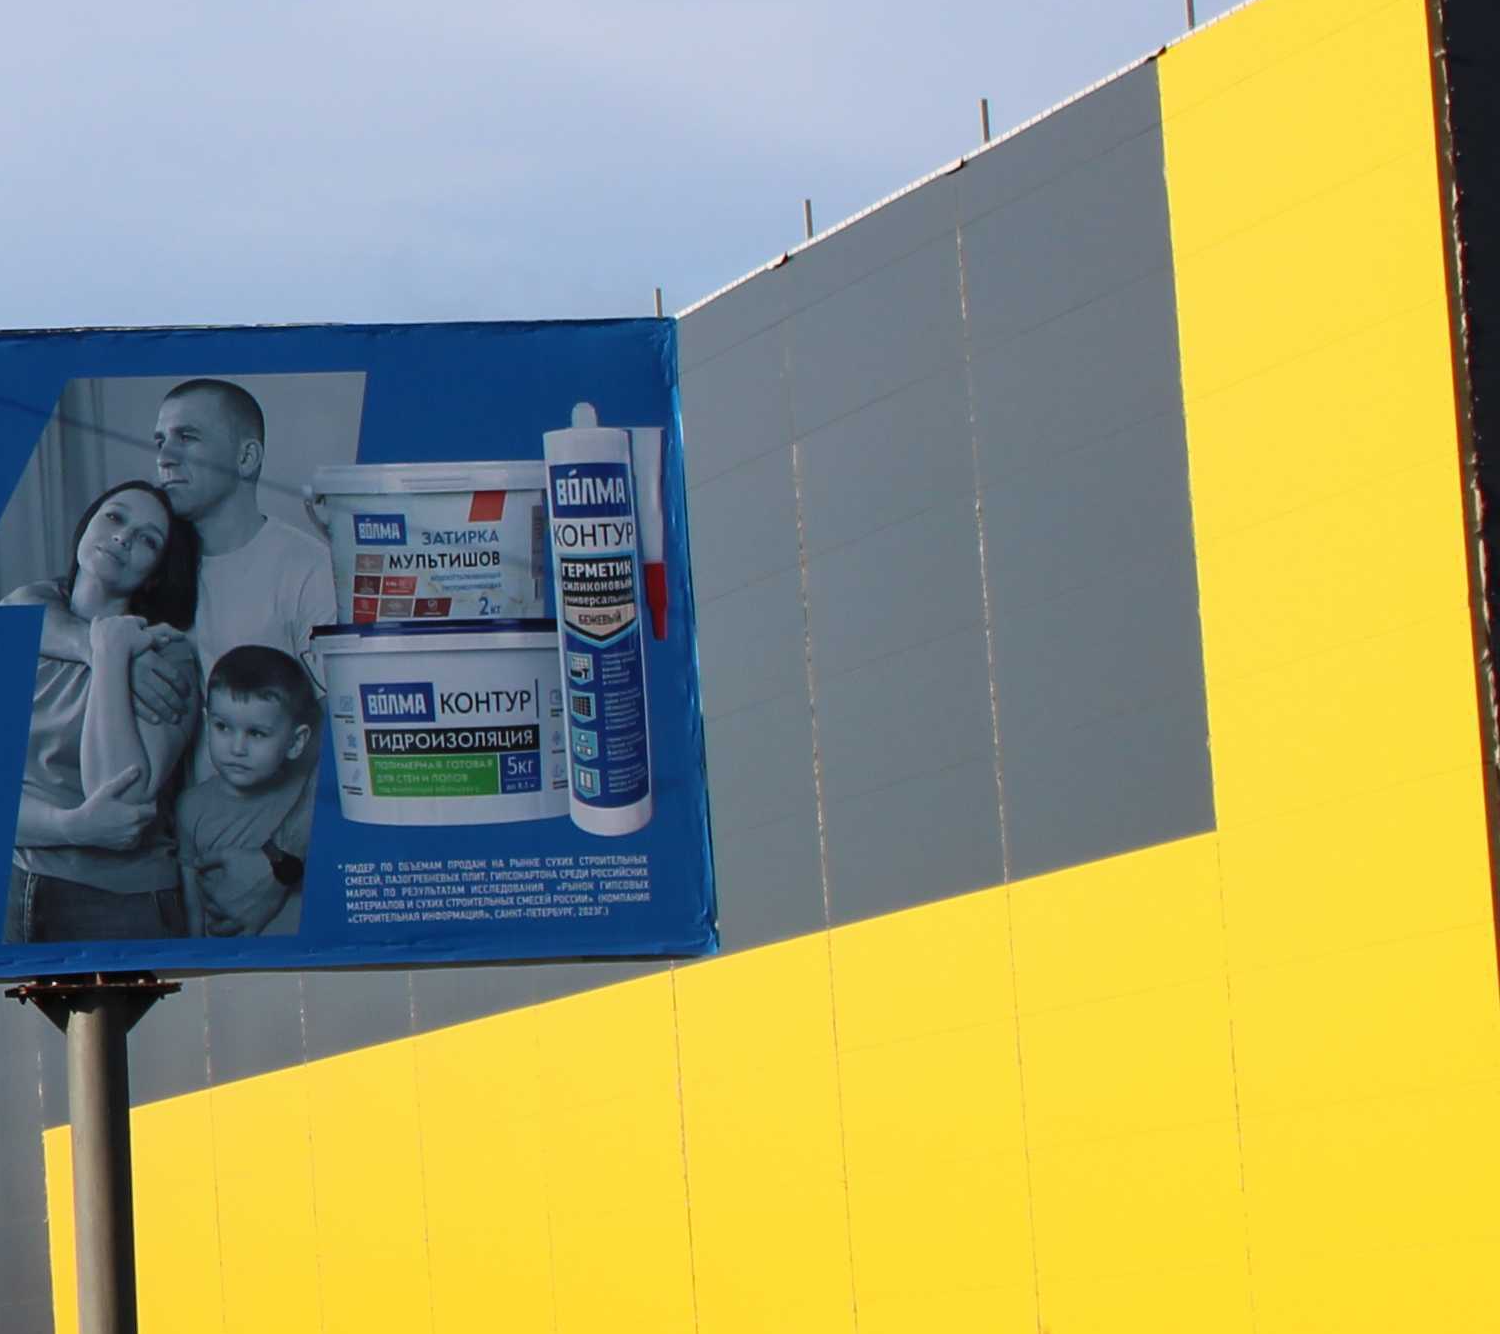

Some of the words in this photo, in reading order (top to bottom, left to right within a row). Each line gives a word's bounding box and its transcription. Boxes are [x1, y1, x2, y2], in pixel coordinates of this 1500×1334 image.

[421, 530, 500, 546] ЗАТИРКА
[554, 522, 634, 548] КОНТУР
[388, 551, 501, 570] МУЛЬТИШОВ
[561, 559, 632, 579] ГЕРМЕТИК
[478, 596, 489, 616] 2
[439, 689, 532, 714] КОНТУР
[371, 728, 534, 752] ГИДРОИЗОЛЯЦИЯ
[491, 858, 505, 868] НА
[509, 857, 541, 868] РЫНКЕ
[545, 856, 574, 867] СУХИХ
[579, 854, 648, 866] СТРОИТЕЛЬНЫХ
[559, 868, 590, 880] СРЕДИ
[345, 888, 379, 899] МАРОК
[383, 887, 396, 898] ПО
[401, 885, 465, 898] РЕЗУЛЬТАТАМ
[599, 880, 650, 890] ГИПСОВЫХ
[346, 899, 406, 912] МАТЕРИАЛОВ
[415, 898, 445, 910] СУХИХ
[445, 895, 516, 909] СТРОИТЕЛЬНЫХ
[516, 893, 552, 906] СМЕСЕЙ
